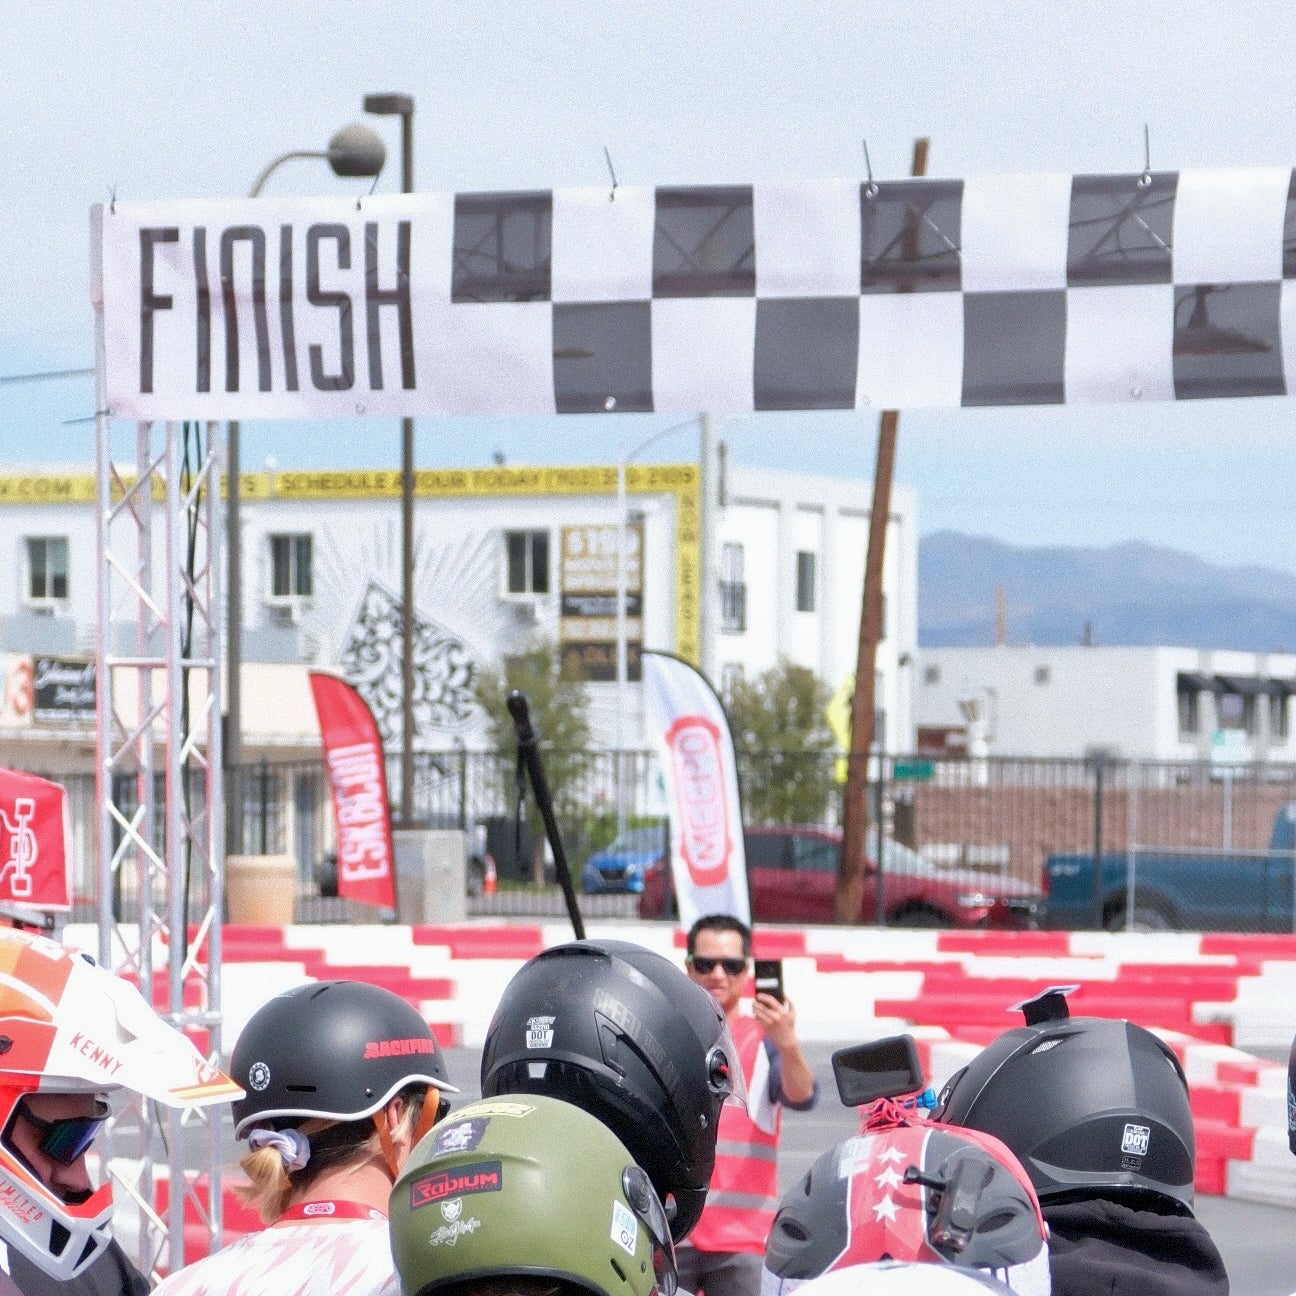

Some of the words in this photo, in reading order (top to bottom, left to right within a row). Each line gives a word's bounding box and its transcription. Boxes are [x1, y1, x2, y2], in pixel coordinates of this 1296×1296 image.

[138, 219, 416, 393] FINISH
[531, 1030, 548, 1041] DOT
[69, 1031, 124, 1076] KENNY
[1124, 1132, 1148, 1148] DOT
